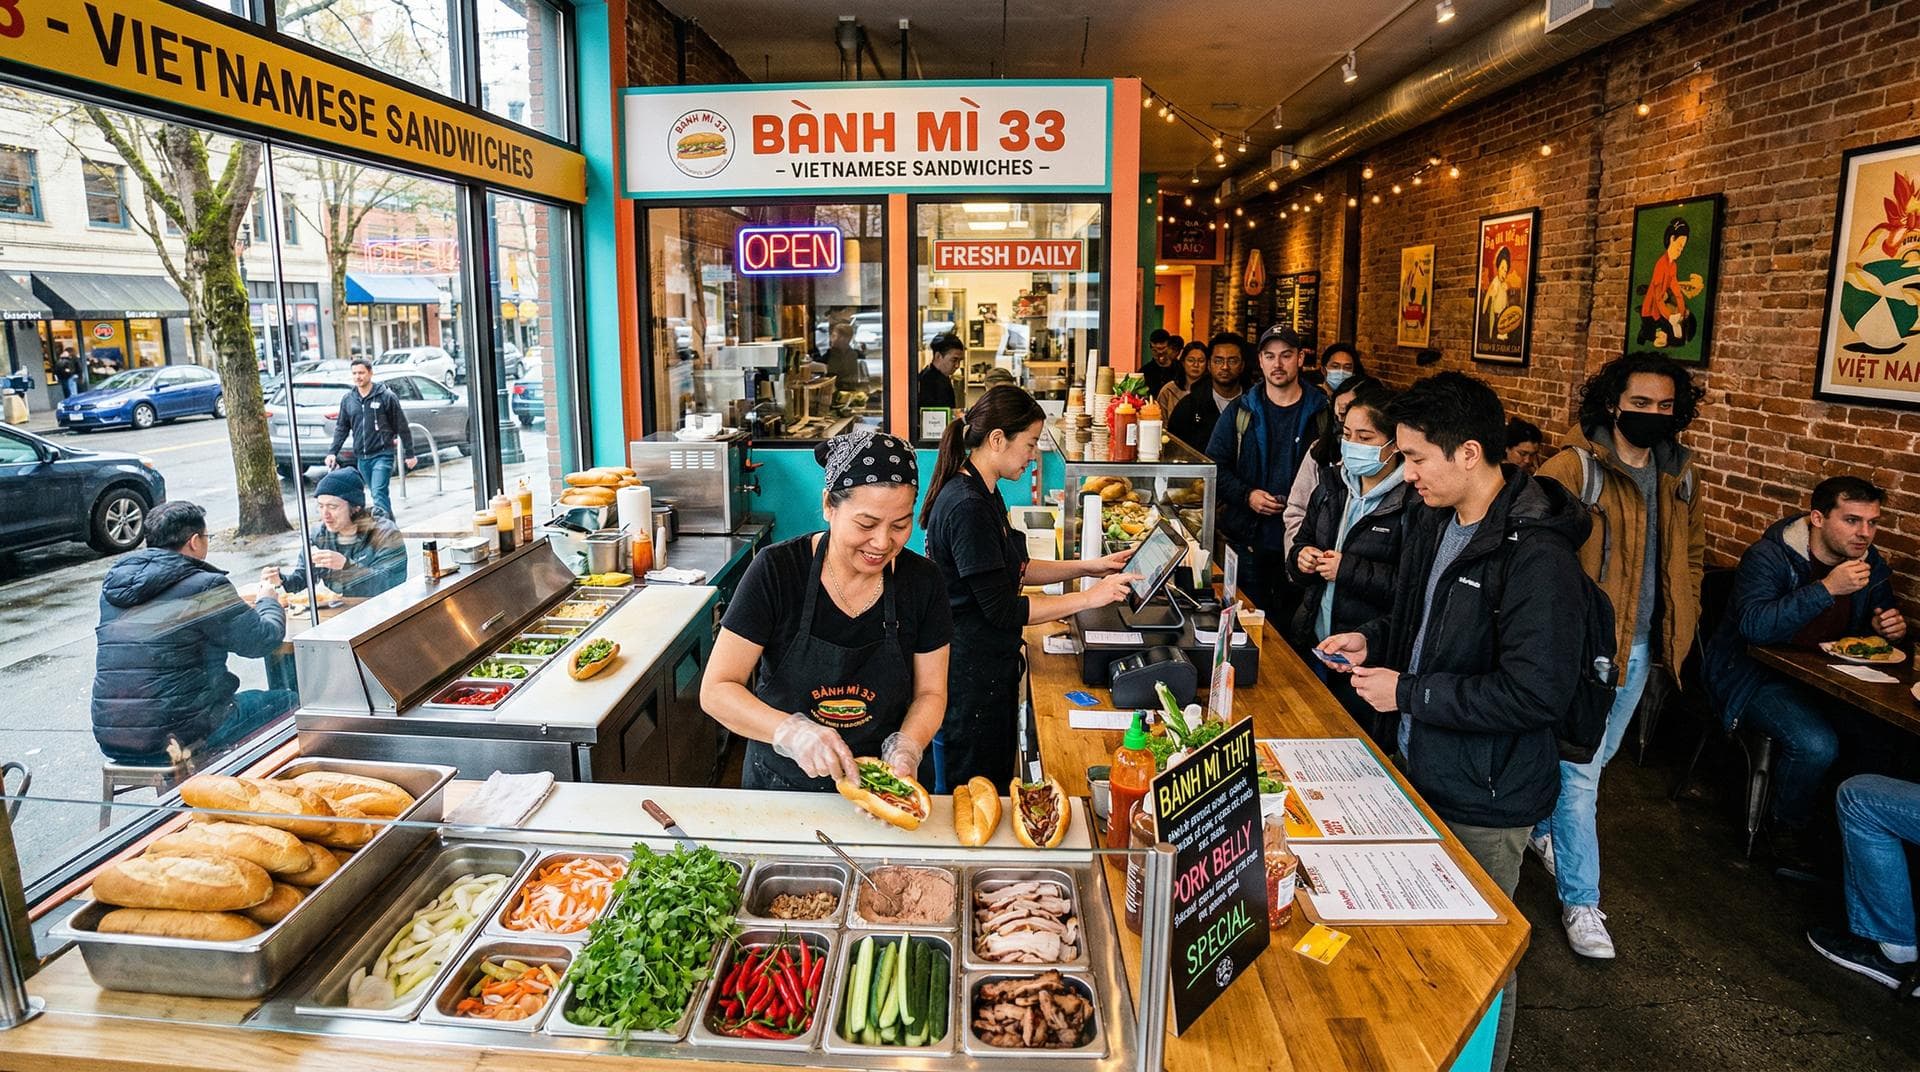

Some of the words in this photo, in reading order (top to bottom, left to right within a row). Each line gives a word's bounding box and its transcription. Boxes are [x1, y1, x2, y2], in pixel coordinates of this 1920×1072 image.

[84, 2, 378, 138] VIETNAMESE
[386, 104, 535, 179] SANDWICHES
[752, 99, 896, 155] BÀNH
[917, 97, 980, 152] MÌ
[999, 110, 1066, 152] 33
[791, 161, 906, 178] VIETNAMESE
[913, 159, 1033, 176] SANDWICHES
[745, 233, 835, 269] OPEN
[941, 246, 1010, 266] FRESH
[1016, 245, 1077, 266] DAILY
[1837, 354, 1880, 383] VIỆT
[860, 688, 877, 702] 33
[1212, 820, 1253, 878] BELLY
[1186, 899, 1251, 975] SPECIAL
